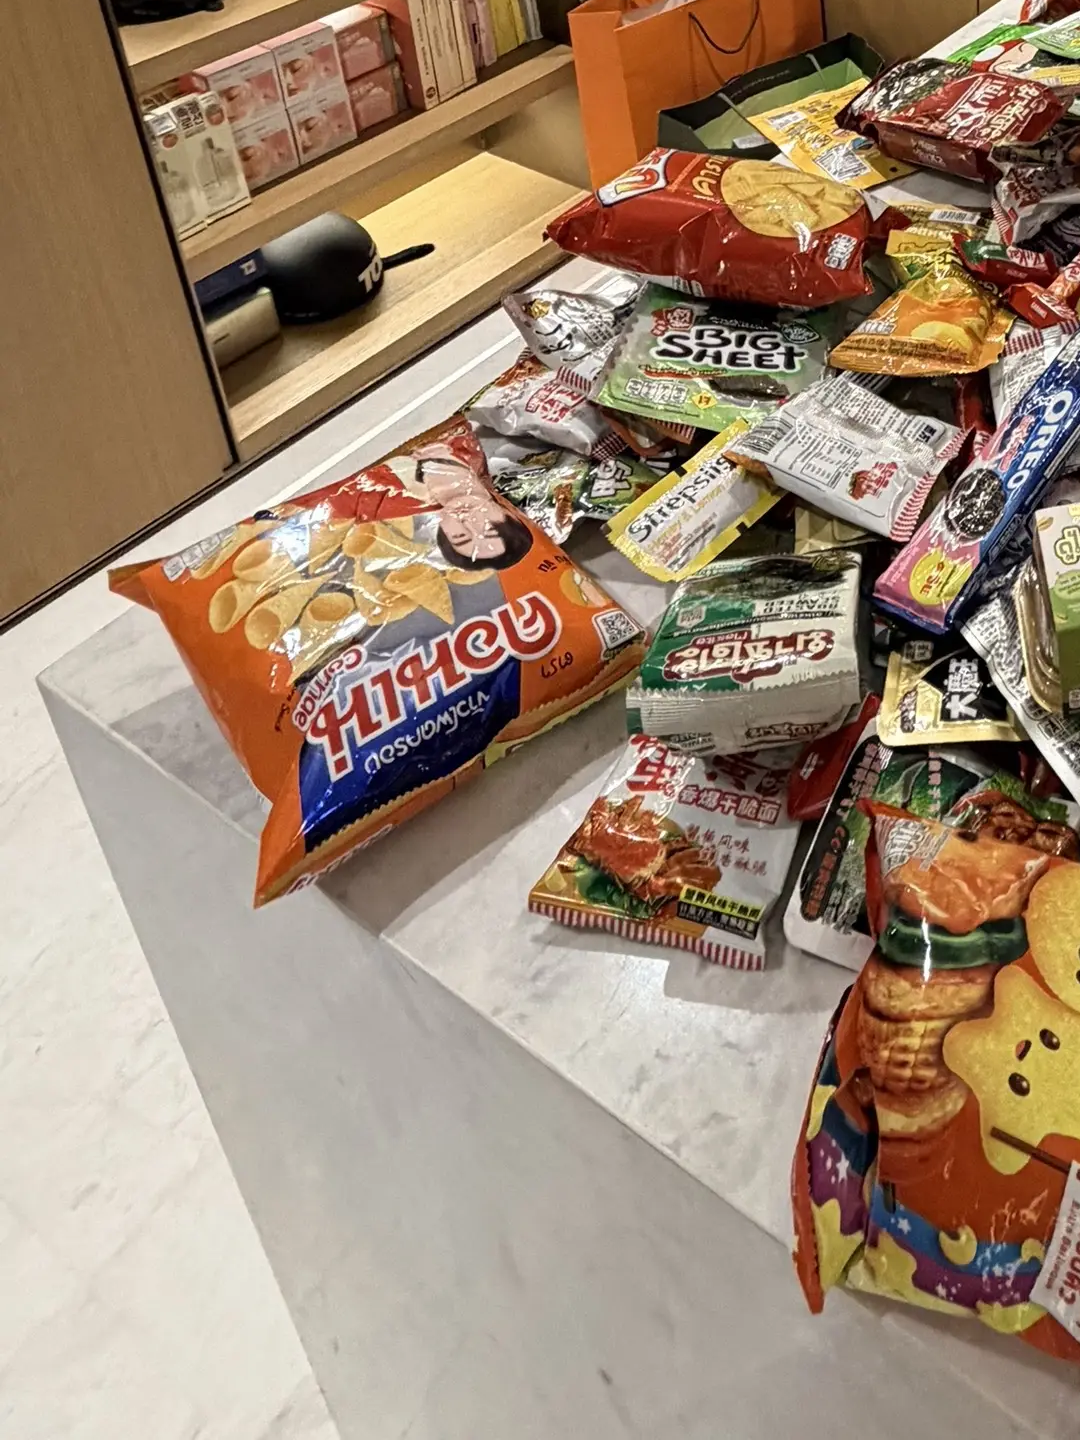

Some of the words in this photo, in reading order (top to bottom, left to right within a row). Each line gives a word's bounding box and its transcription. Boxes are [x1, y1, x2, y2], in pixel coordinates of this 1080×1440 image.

[656, 335, 806, 371] SHEET
[695, 328, 782, 350] BIG
[1008, 390, 1074, 491] OREO
[628, 454, 733, 543] Strepsils
[309, 593, 559, 780] คอนเน่
